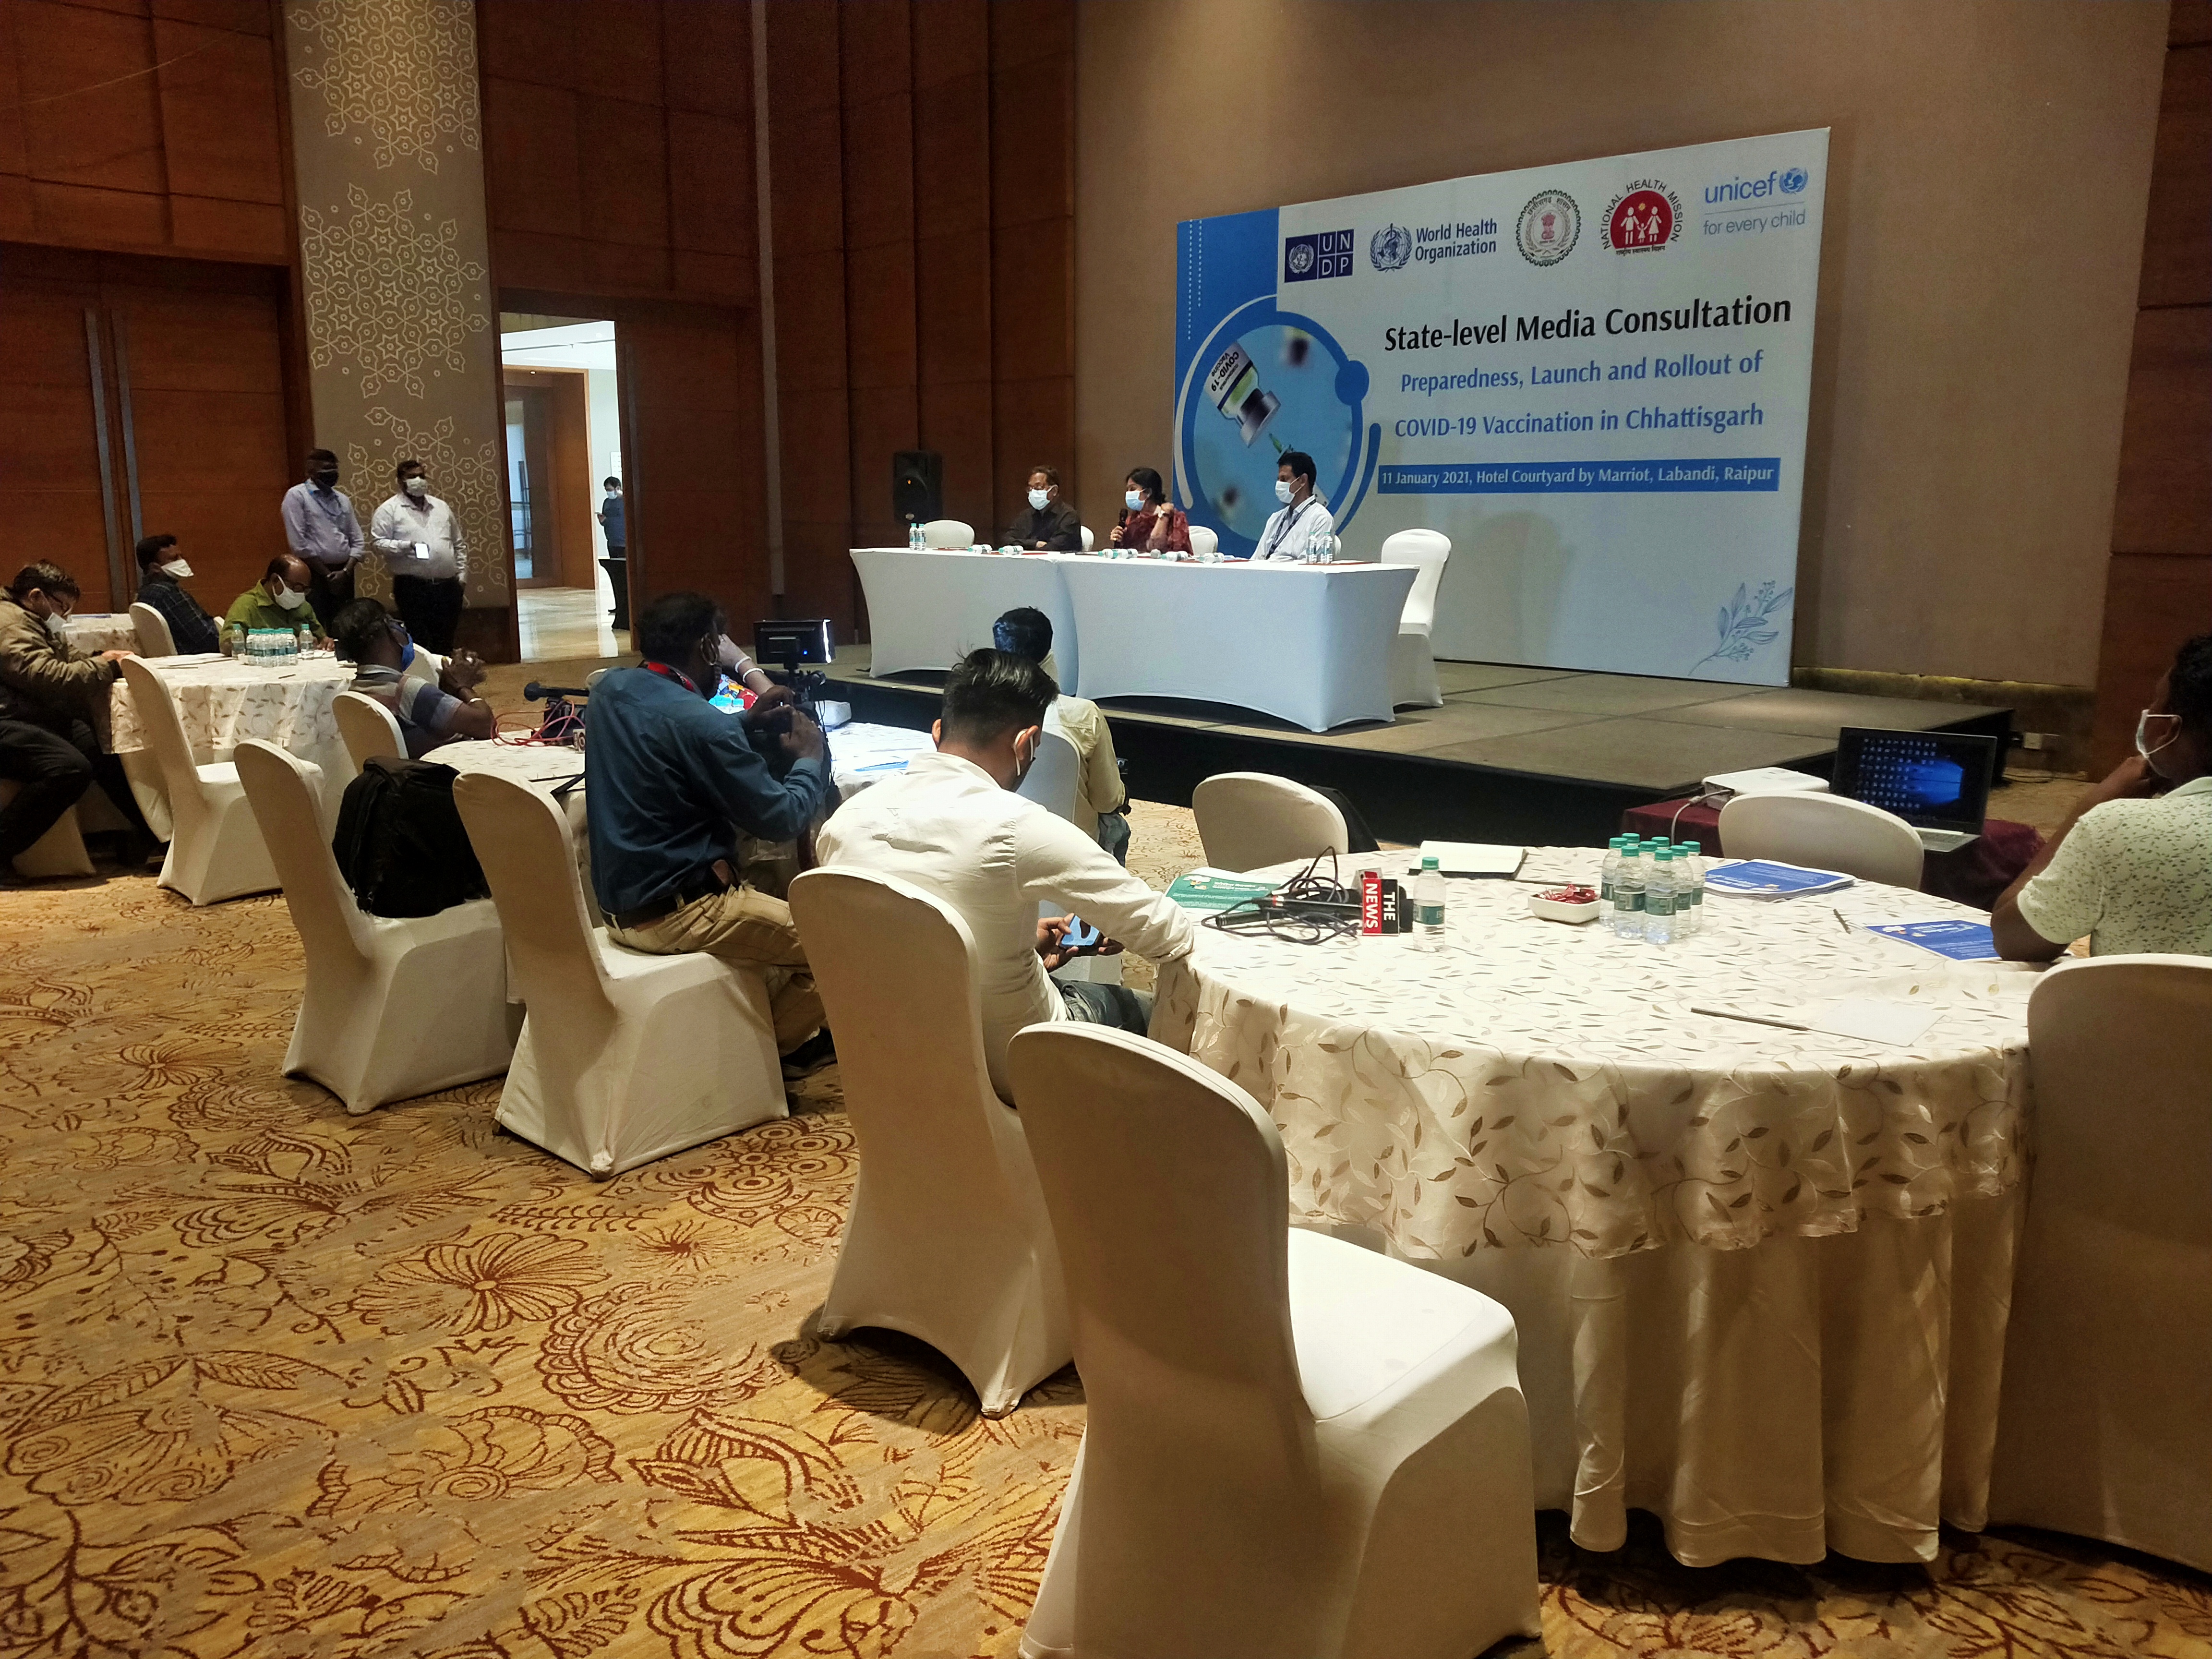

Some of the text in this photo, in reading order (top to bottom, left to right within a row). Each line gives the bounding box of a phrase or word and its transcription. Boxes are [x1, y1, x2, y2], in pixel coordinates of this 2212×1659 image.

[1705, 171, 1777, 204] unicef
[1416, 218, 1497, 243] World Health
[1600, 179, 1683, 250] NATIONAL HEALTH MISSION
[1703, 209, 1806, 235] for every child
[1416, 238, 1496, 264] Organization
[1384, 295, 1791, 351] State-level Media Consultation
[1401, 349, 1764, 397] Preparedness, Launch and Rollout of
[1395, 402, 1764, 437] COVID-19 Vaccination in Chhattisgarh
[1382, 465, 1775, 487] 11 January 2021, Hotel Courtyard by Marriot, Labandi, Raipur
[1366, 883, 1378, 928] NEWS
[1383, 891, 1395, 921] THE
